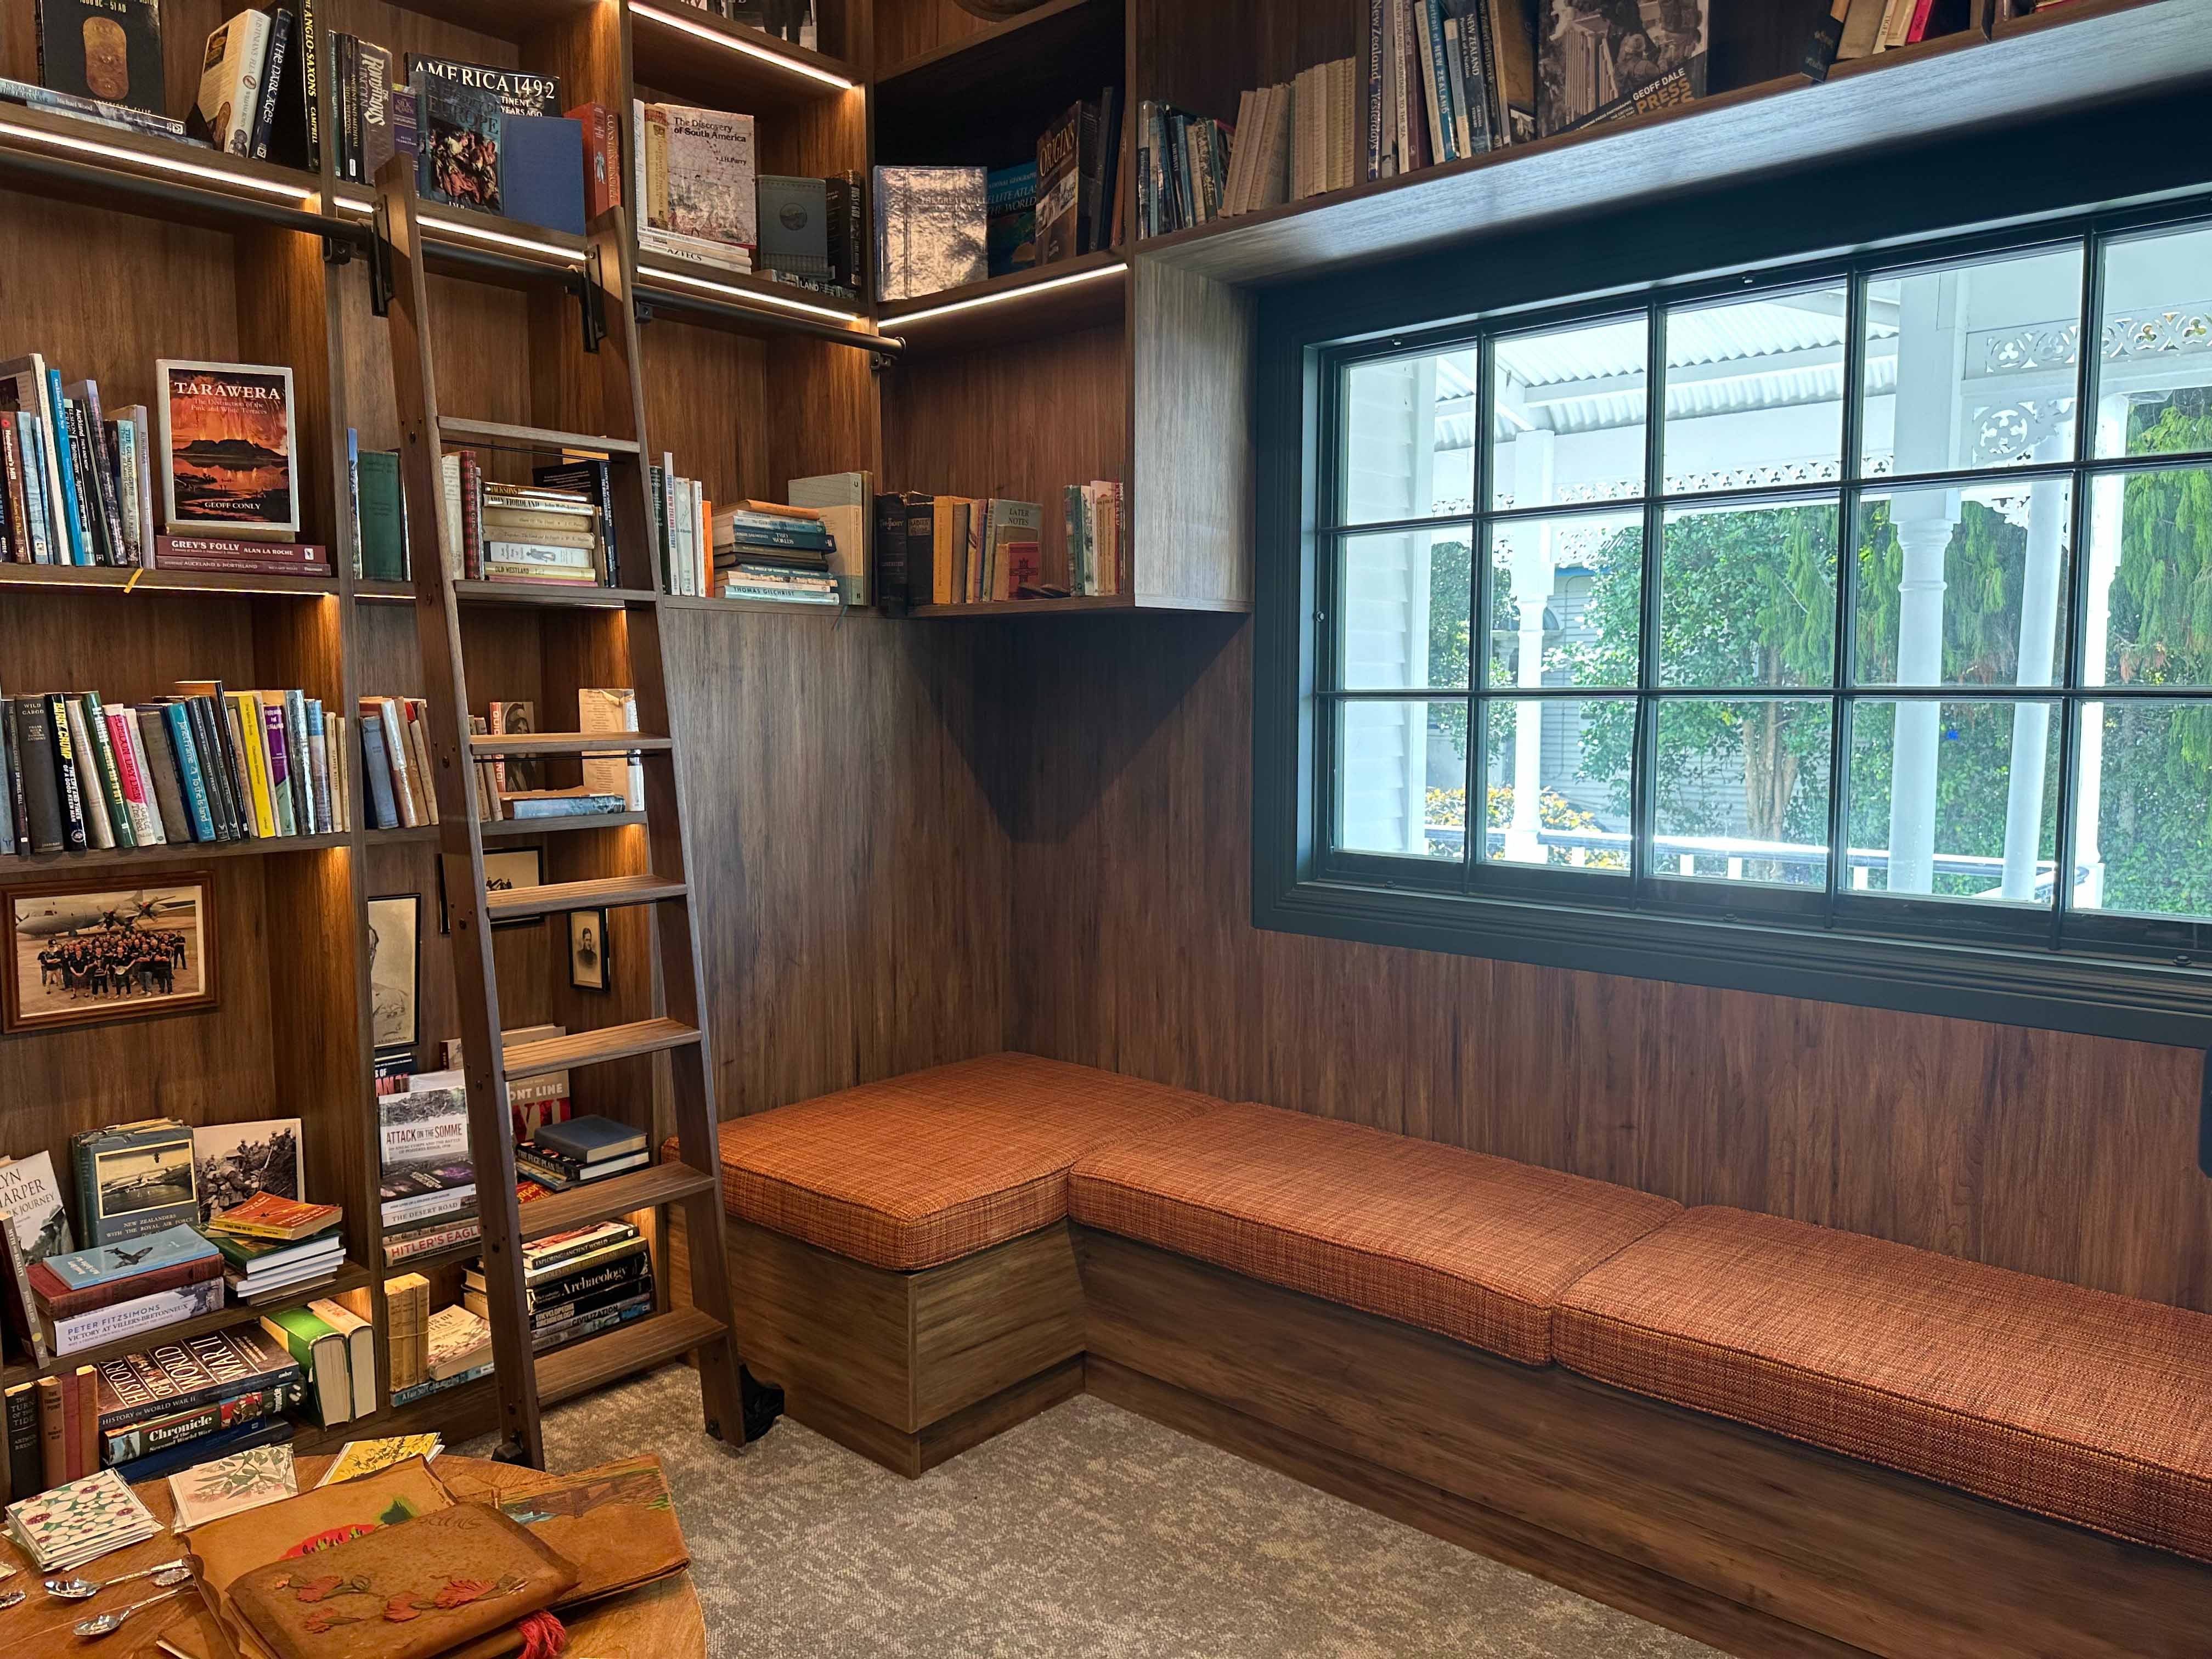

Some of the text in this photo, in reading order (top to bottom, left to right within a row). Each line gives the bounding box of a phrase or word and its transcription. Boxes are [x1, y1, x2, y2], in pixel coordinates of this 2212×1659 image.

[303, 9, 317, 97] ANGLO-SAXONS
[1434, 45, 1443, 66] NEW
[1466, 14, 1480, 76] NEW ZEALAND
[268, 65, 281, 96] DARK
[415, 60, 555, 99] AMERICA 1492
[1369, 0, 1381, 150] New Zealand Yesterdays
[1632, 67, 1686, 101] GEOFF DALE
[1437, 70, 1448, 114] ZEALAND
[1635, 77, 1690, 115] PRESS
[500, 105, 526, 116] YEARS
[1400, 99, 1406, 109] TO
[674, 116, 733, 133] The Discovery
[685, 127, 710, 138] South
[712, 131, 746, 142] America
[1040, 119, 1075, 177] ORIGINS
[1005, 196, 1036, 211] WORLD
[800, 281, 819, 291] LAND
[54, 377, 63, 403] Auckland
[174, 382, 281, 400] TARAWERA
[208, 399, 245, 408] Destruction
[68, 409, 77, 436] ELSDON
[75, 409, 84, 437] Auckland
[5, 430, 17, 480] Henderson's Mill
[233, 502, 261, 510] CONLY
[506, 498, 540, 507] FIORDLAND
[1009, 507, 1030, 517] LATER
[1008, 517, 1029, 526] NOTES
[172, 540, 207, 549] GREY'S
[210, 543, 240, 551] FOLLY
[505, 566, 529, 574] WESTLAND
[54, 702, 72, 759] BARRY CRUMP
[177, 720, 194, 764] Janet Frame
[115, 714, 142, 800] GORDON DRYDEN
[192, 777, 208, 822] To the Is-land
[131, 804, 143, 832] The Red
[380, 1068, 387, 1077] OF
[535, 1082, 563, 1097] LINE
[386, 1123, 463, 1144] ATTACK ON THE SOMME
[517, 1149, 555, 1171] THE PLAN
[19, 1193, 55, 1215] JOURNEY
[392, 1201, 458, 1222] THE DESERT ROAD
[139, 1214, 177, 1225] ZEALANDERS
[391, 1234, 445, 1257] HITLER'S
[534, 1238, 608, 1267] EXPLORING ANCIENT WORLD
[13, 1253, 24, 1277] REALITY
[561, 1266, 628, 1296] Archaeology
[67, 1322, 98, 1335] PETER
[102, 1304, 161, 1325] FITZSIMONS
[68, 1329, 100, 1342] VICTORY
[112, 1304, 188, 1330] VILLERS-BRETONNEUX
[572, 1304, 619, 1326] CIVILIZATION
[100, 1335, 248, 1404] HISTORY WORLD WAR II
[13, 1414, 35, 1426] TIDE
[101, 1413, 134, 1425] HISTORY
[143, 1403, 171, 1414] WORLD
[172, 1399, 188, 1409] WAR
[149, 1416, 213, 1442] Chronicle
[149, 1440, 176, 1452] Second
[177, 1432, 198, 1443] World
